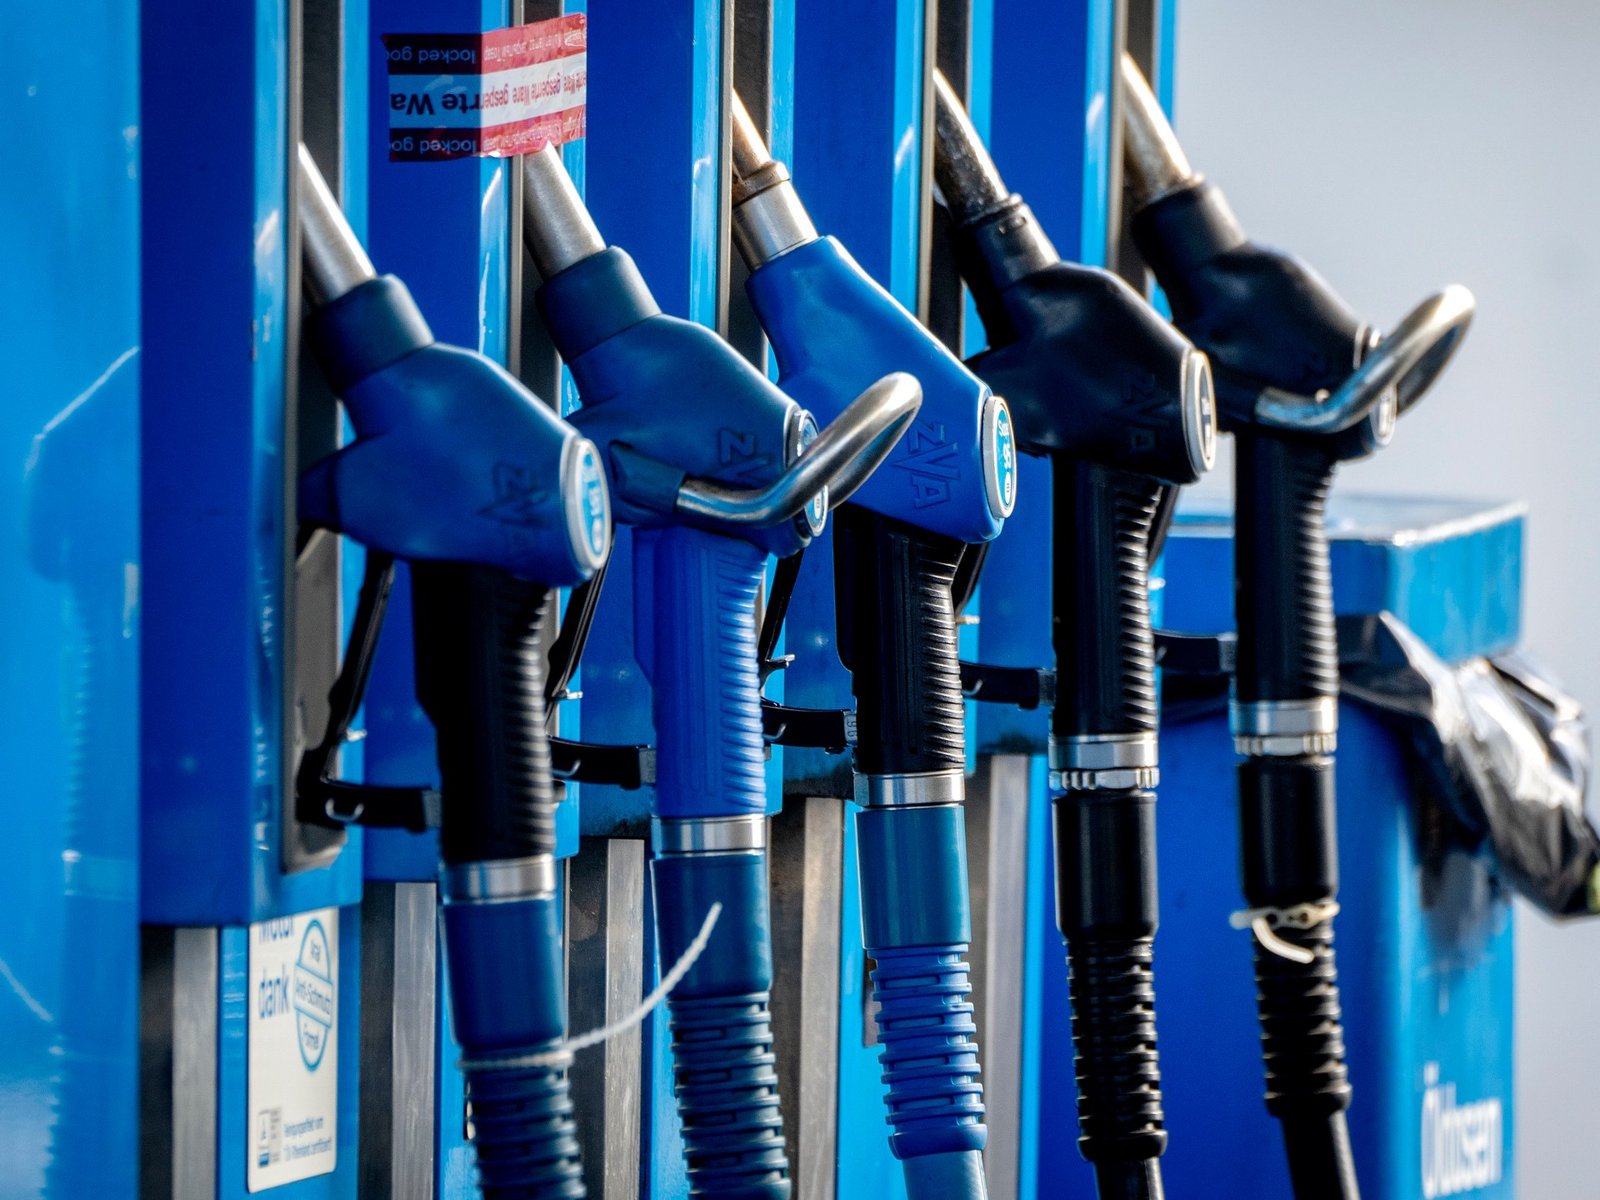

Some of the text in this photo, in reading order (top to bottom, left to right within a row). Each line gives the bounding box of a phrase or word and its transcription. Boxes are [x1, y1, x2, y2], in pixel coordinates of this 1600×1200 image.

[418, 49, 475, 64] locked
[390, 93, 435, 115] Wa
[389, 136, 476, 155] locked go
[888, 418, 961, 510] ZVA
[258, 964, 289, 1020] dank
